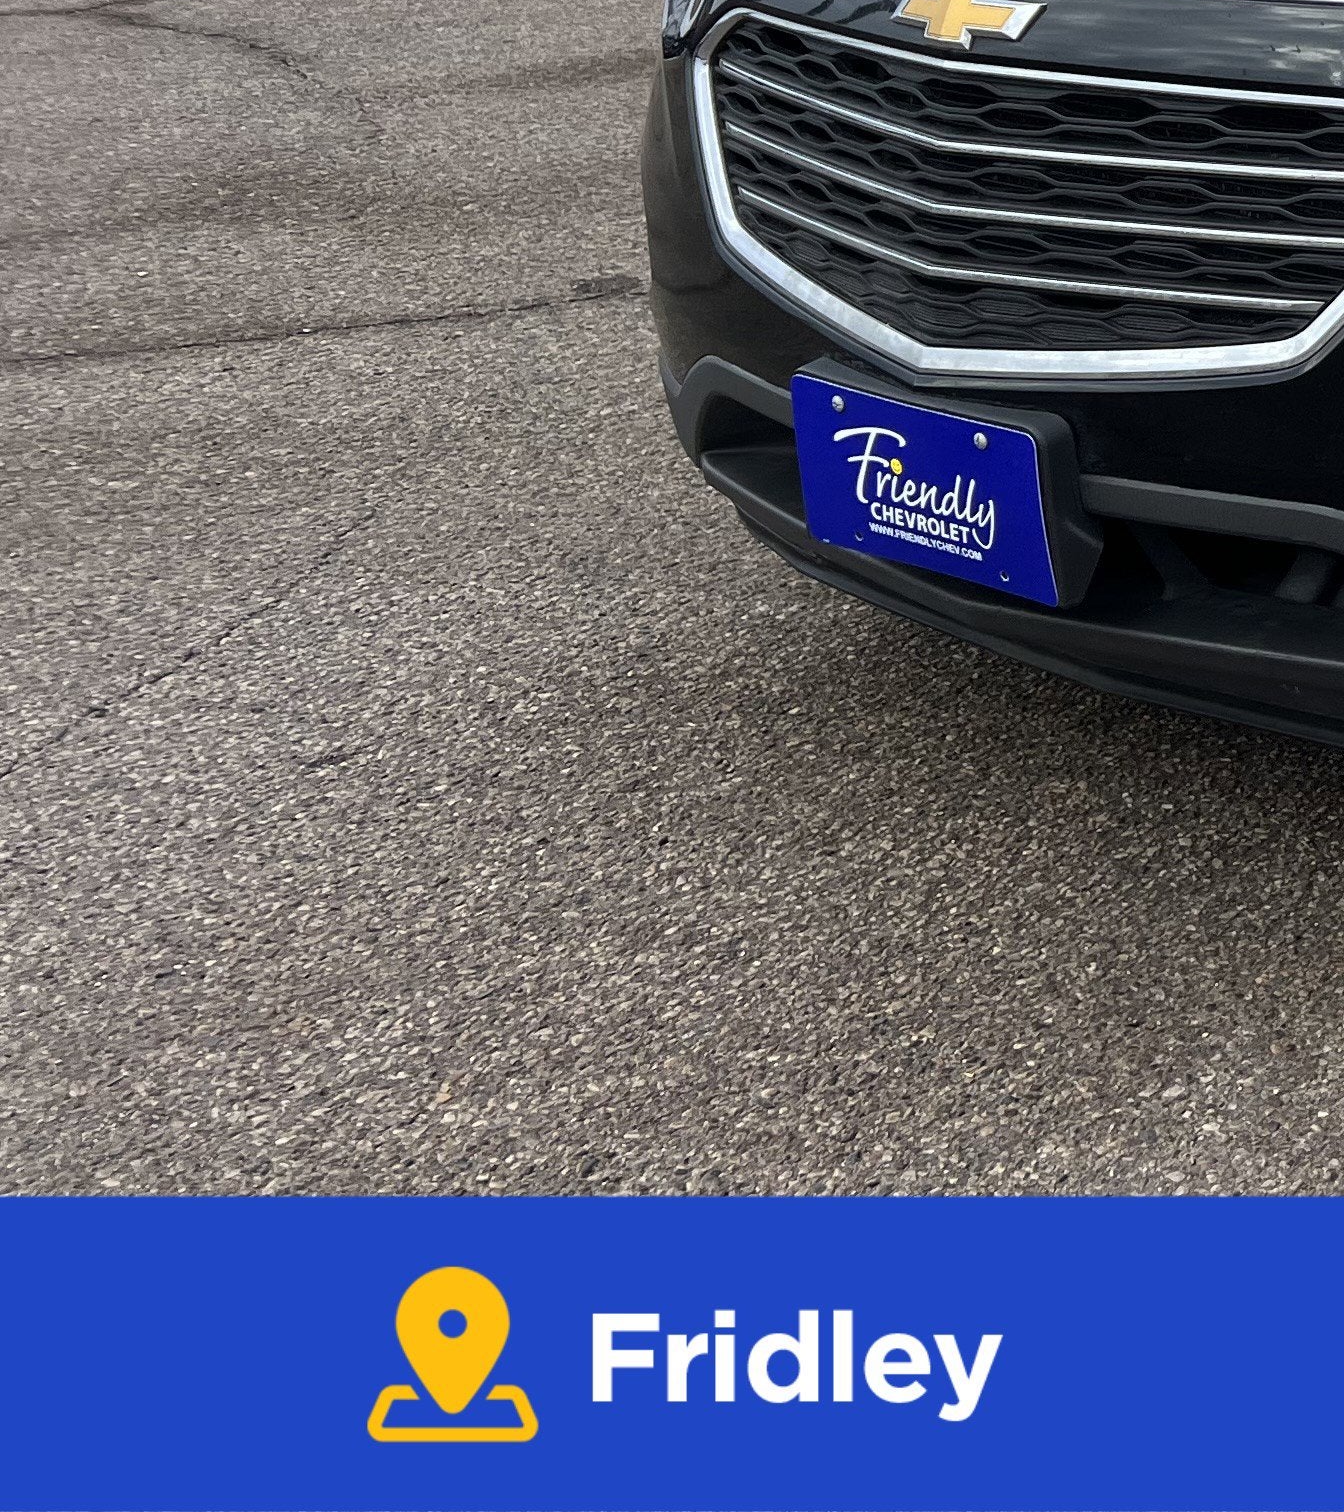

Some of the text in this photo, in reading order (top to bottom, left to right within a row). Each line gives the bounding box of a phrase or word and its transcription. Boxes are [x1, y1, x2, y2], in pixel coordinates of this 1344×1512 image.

[833, 426, 995, 549] Friendly
[868, 521, 983, 561] WWW.FRIENDLYCHEV.COM
[870, 502, 970, 544] CHEVROLET
